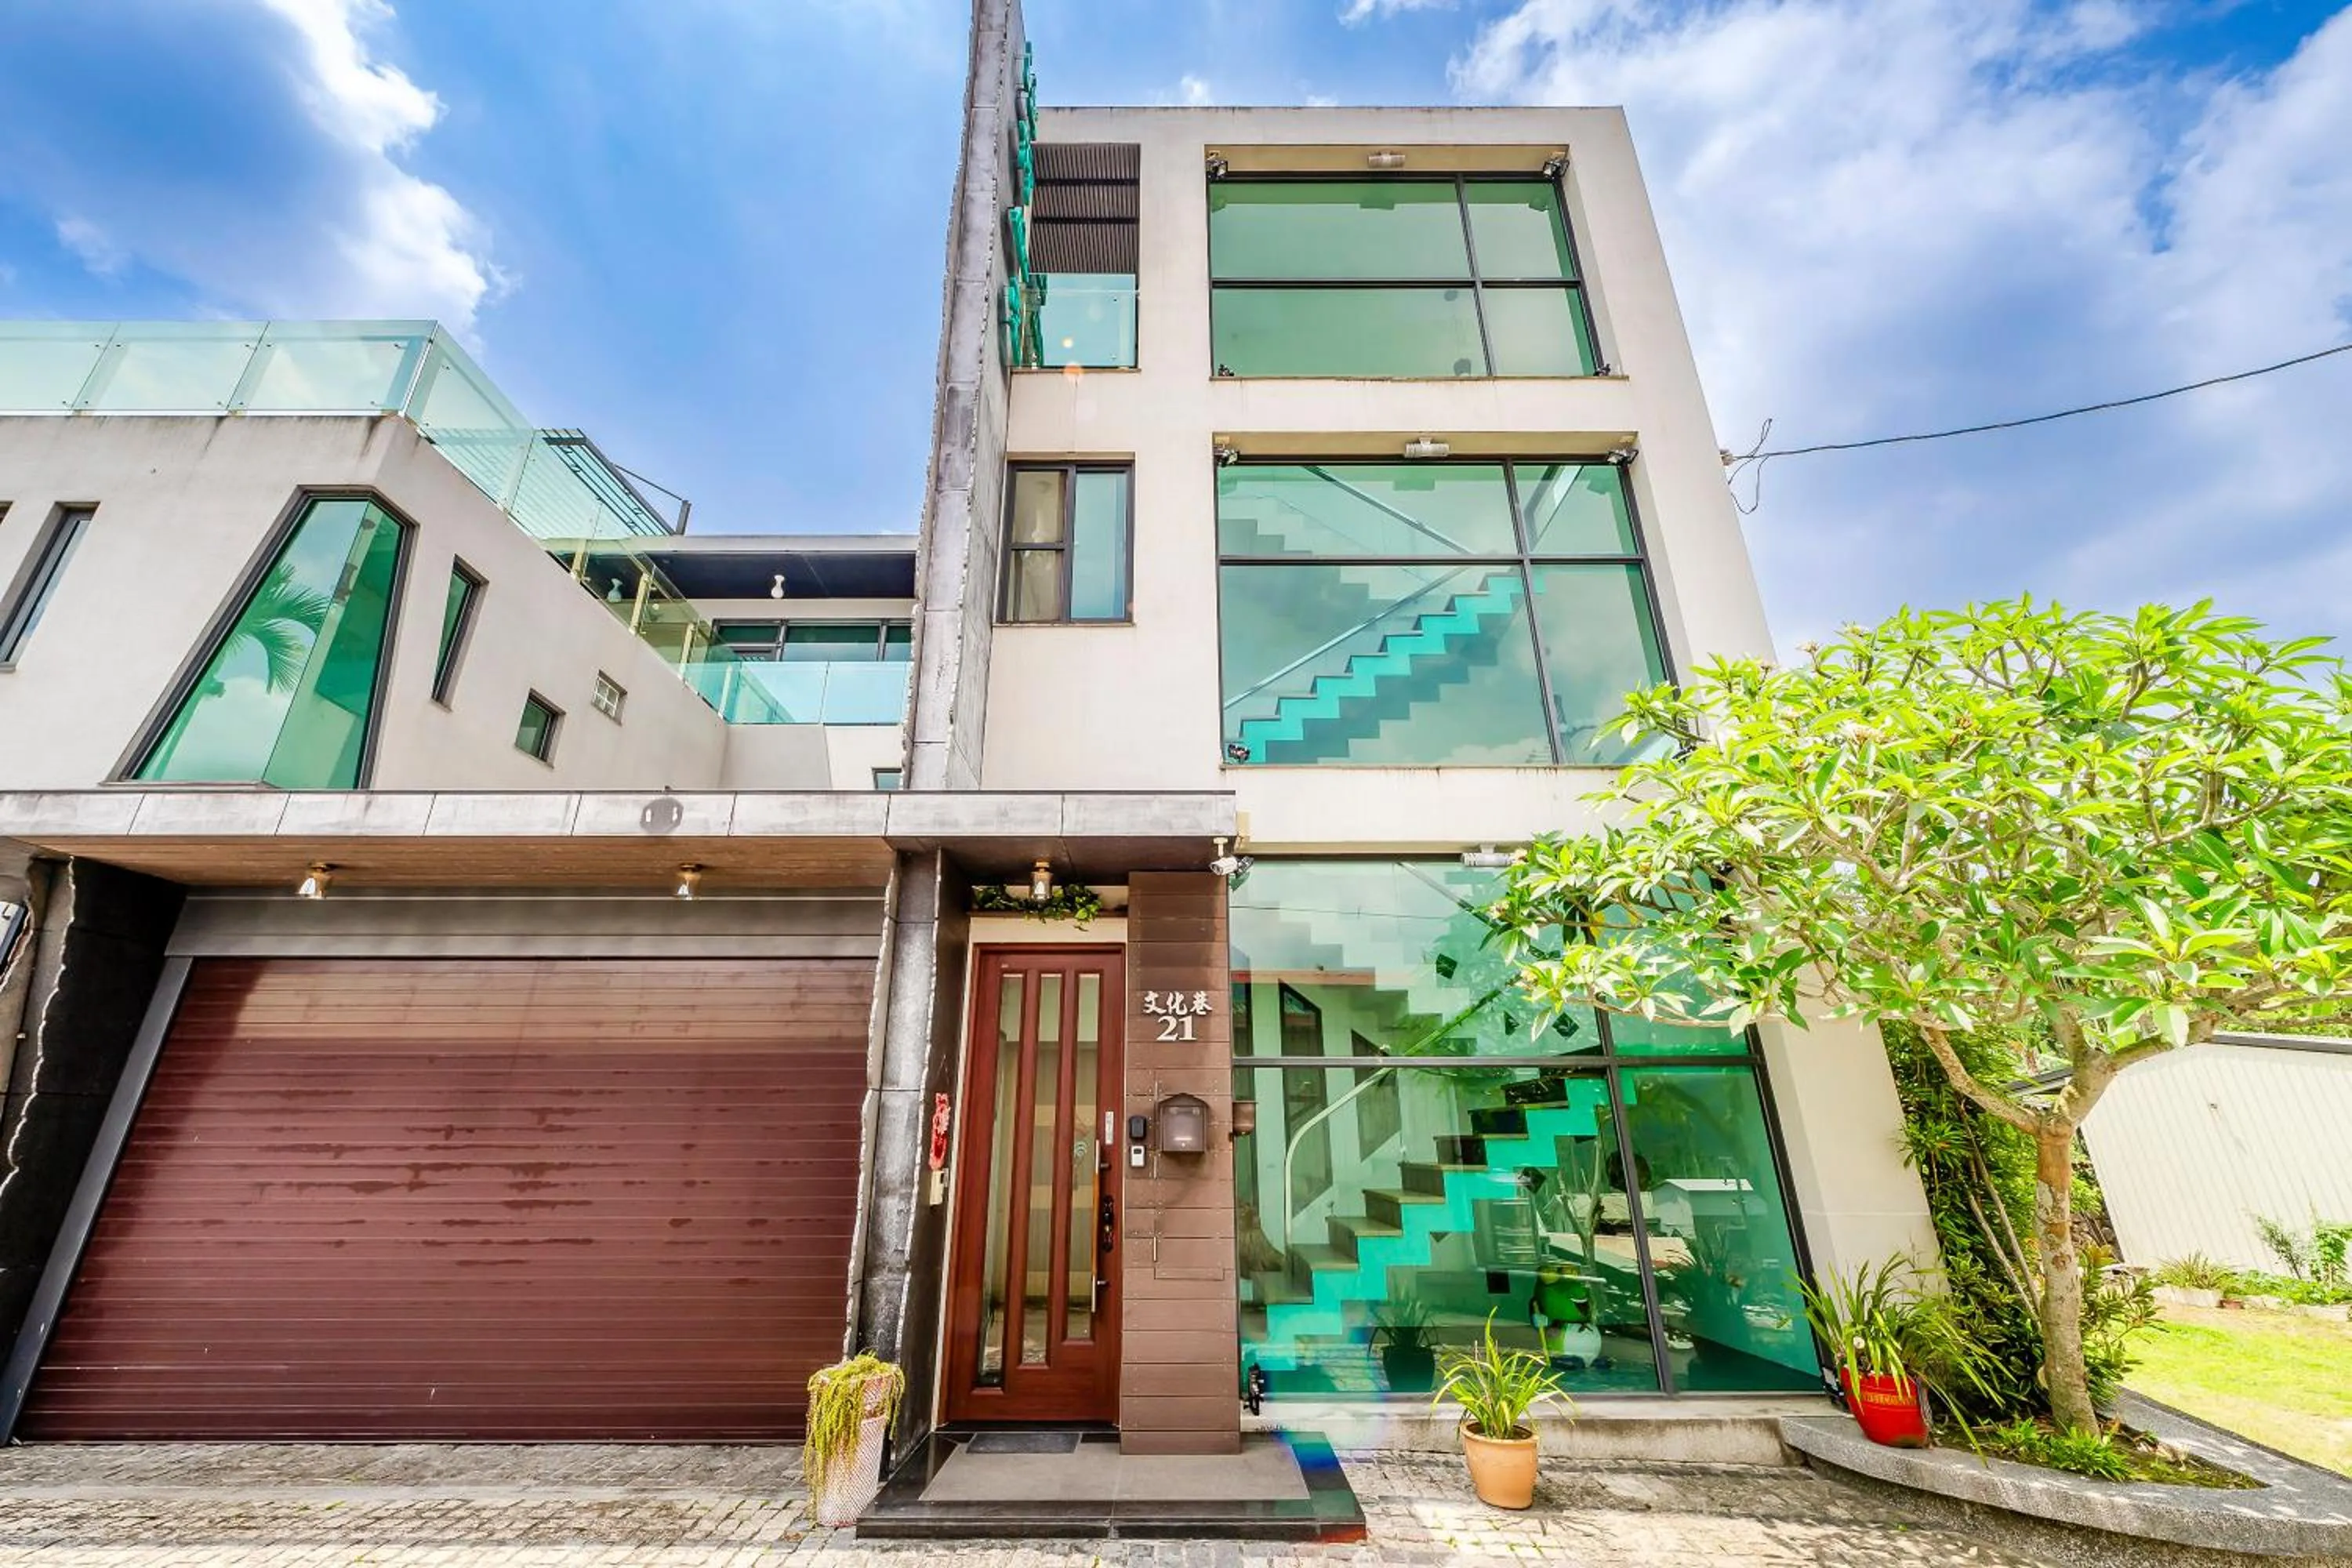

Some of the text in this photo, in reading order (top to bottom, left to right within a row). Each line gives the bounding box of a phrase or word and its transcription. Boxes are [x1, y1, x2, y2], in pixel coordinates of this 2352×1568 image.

[1143, 990, 1213, 1015] 文化巷
[1156, 1015, 1197, 1041] 21
